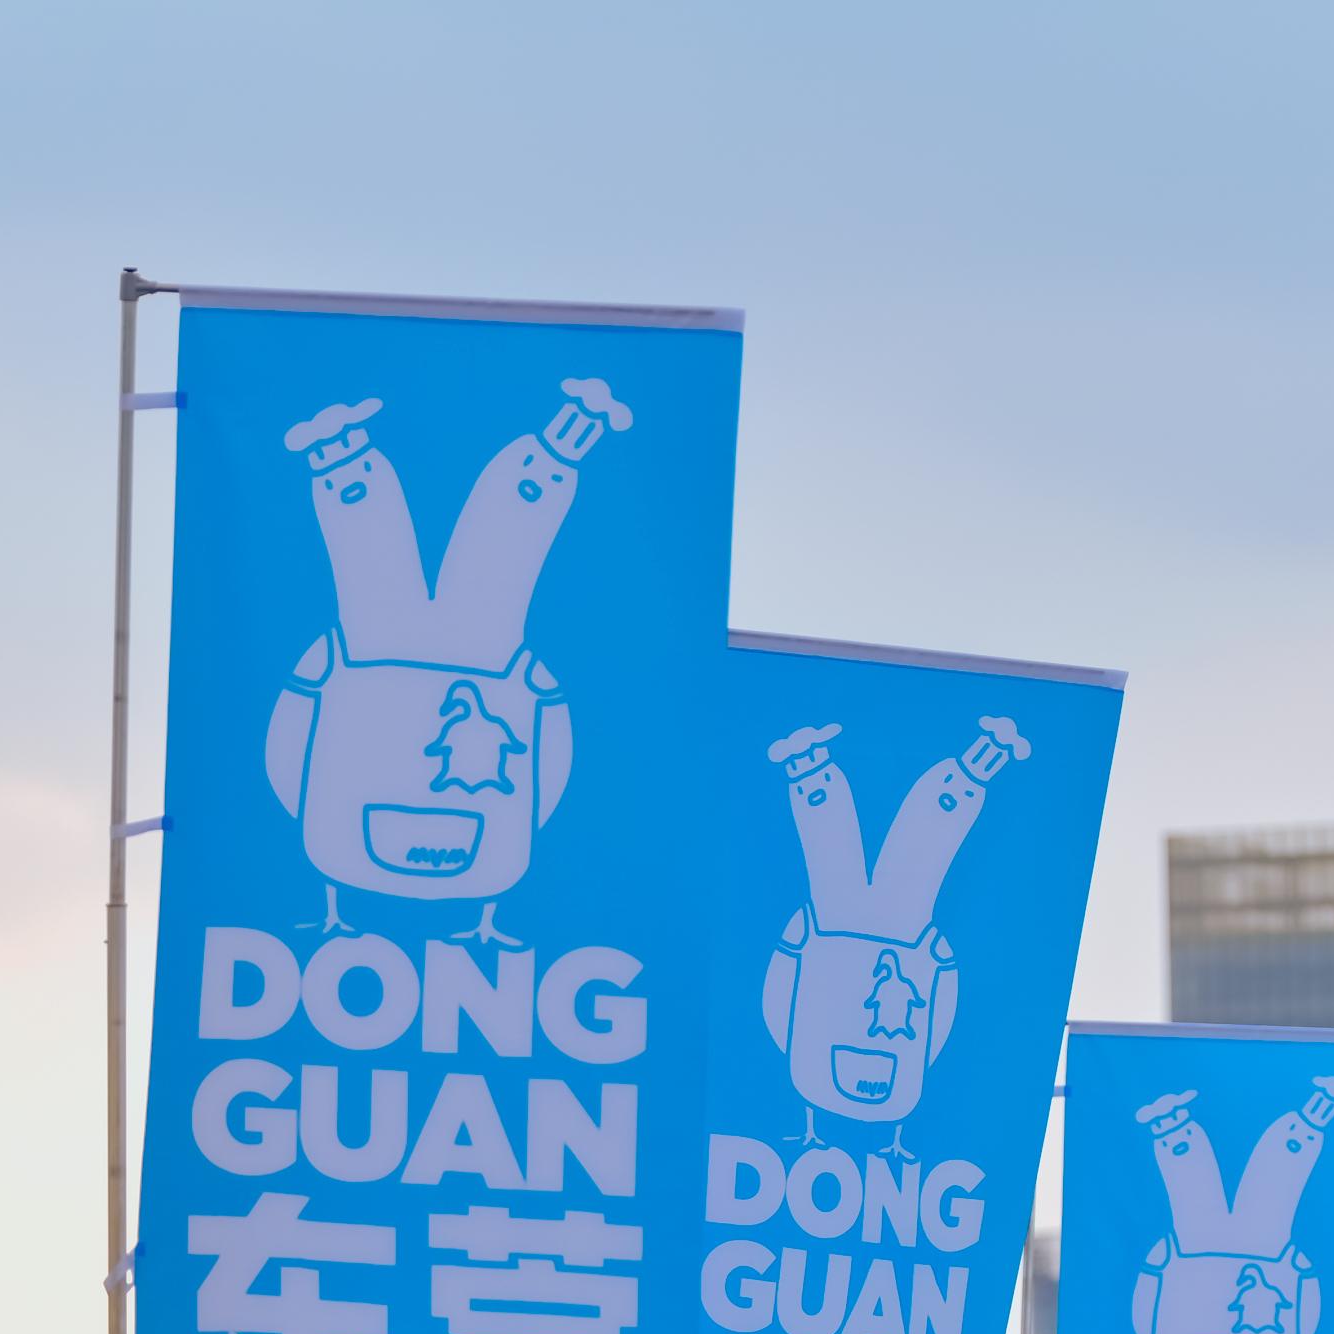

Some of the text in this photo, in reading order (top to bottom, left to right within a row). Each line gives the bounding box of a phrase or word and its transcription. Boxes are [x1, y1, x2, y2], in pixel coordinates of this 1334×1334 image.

[198, 926, 648, 1065] DONG
[191, 1058, 638, 1197] GUAN
[705, 1133, 986, 1253] DONG
